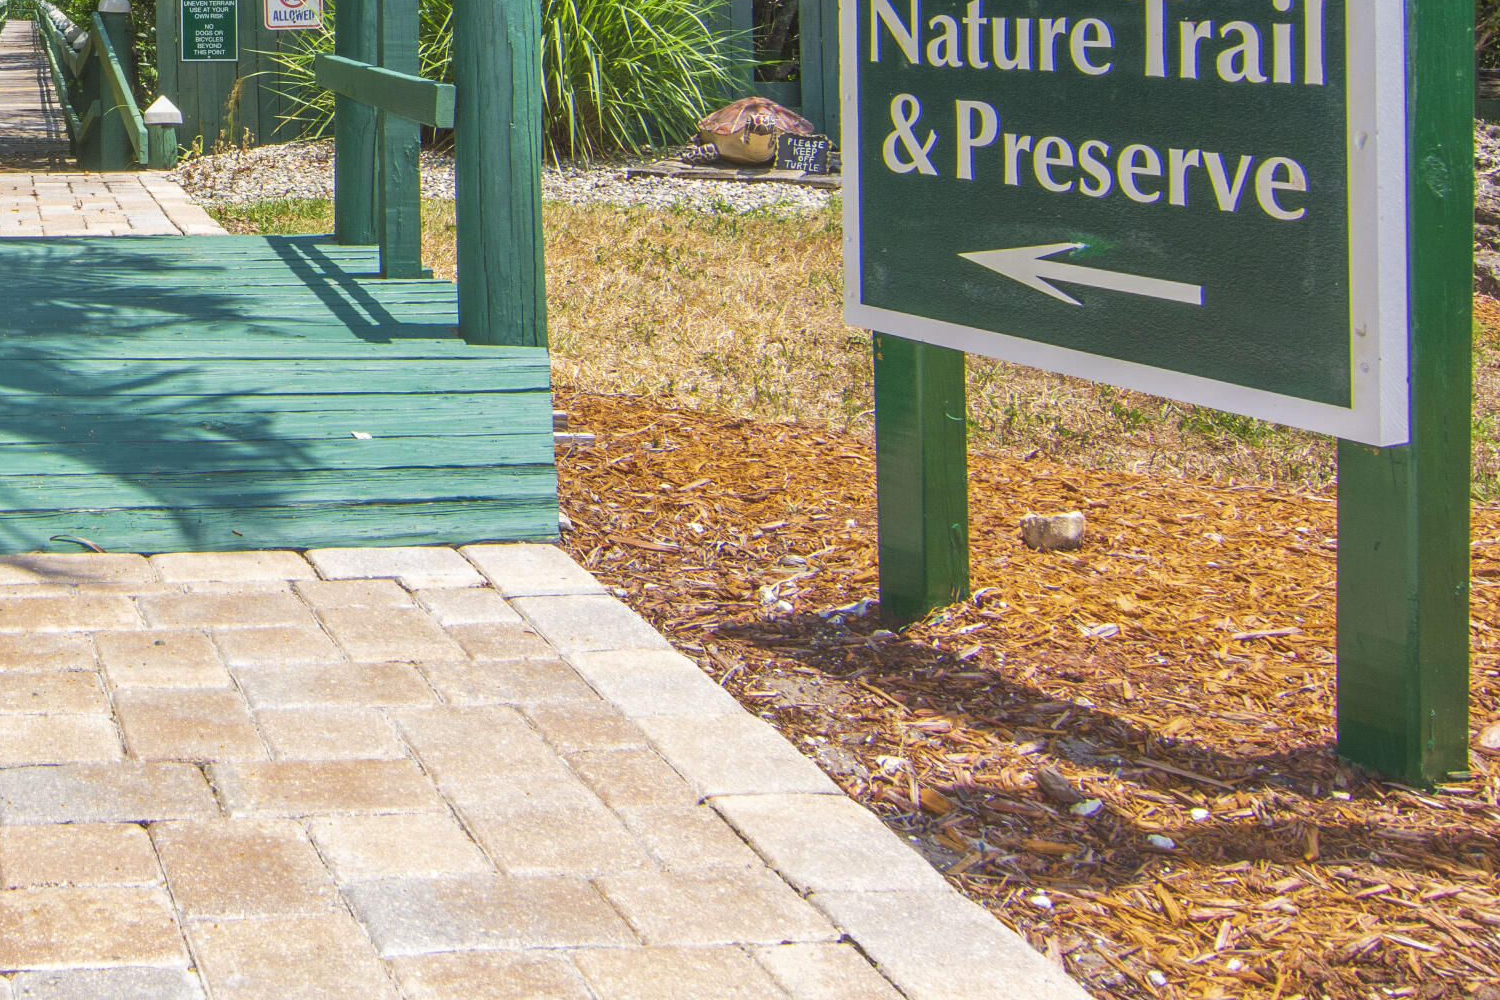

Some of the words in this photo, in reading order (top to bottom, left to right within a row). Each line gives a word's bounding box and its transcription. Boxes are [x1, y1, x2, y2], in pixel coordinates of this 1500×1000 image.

[273, 9, 315, 21] ALLOWED
[787, 138, 826, 149] PLEASE
[793, 147, 818, 157] KEEP
[883, 93, 939, 176] &
[956, 99, 1308, 220] Preserve
[798, 155, 816, 163] OFF
[784, 160, 820, 172] TURTLE
